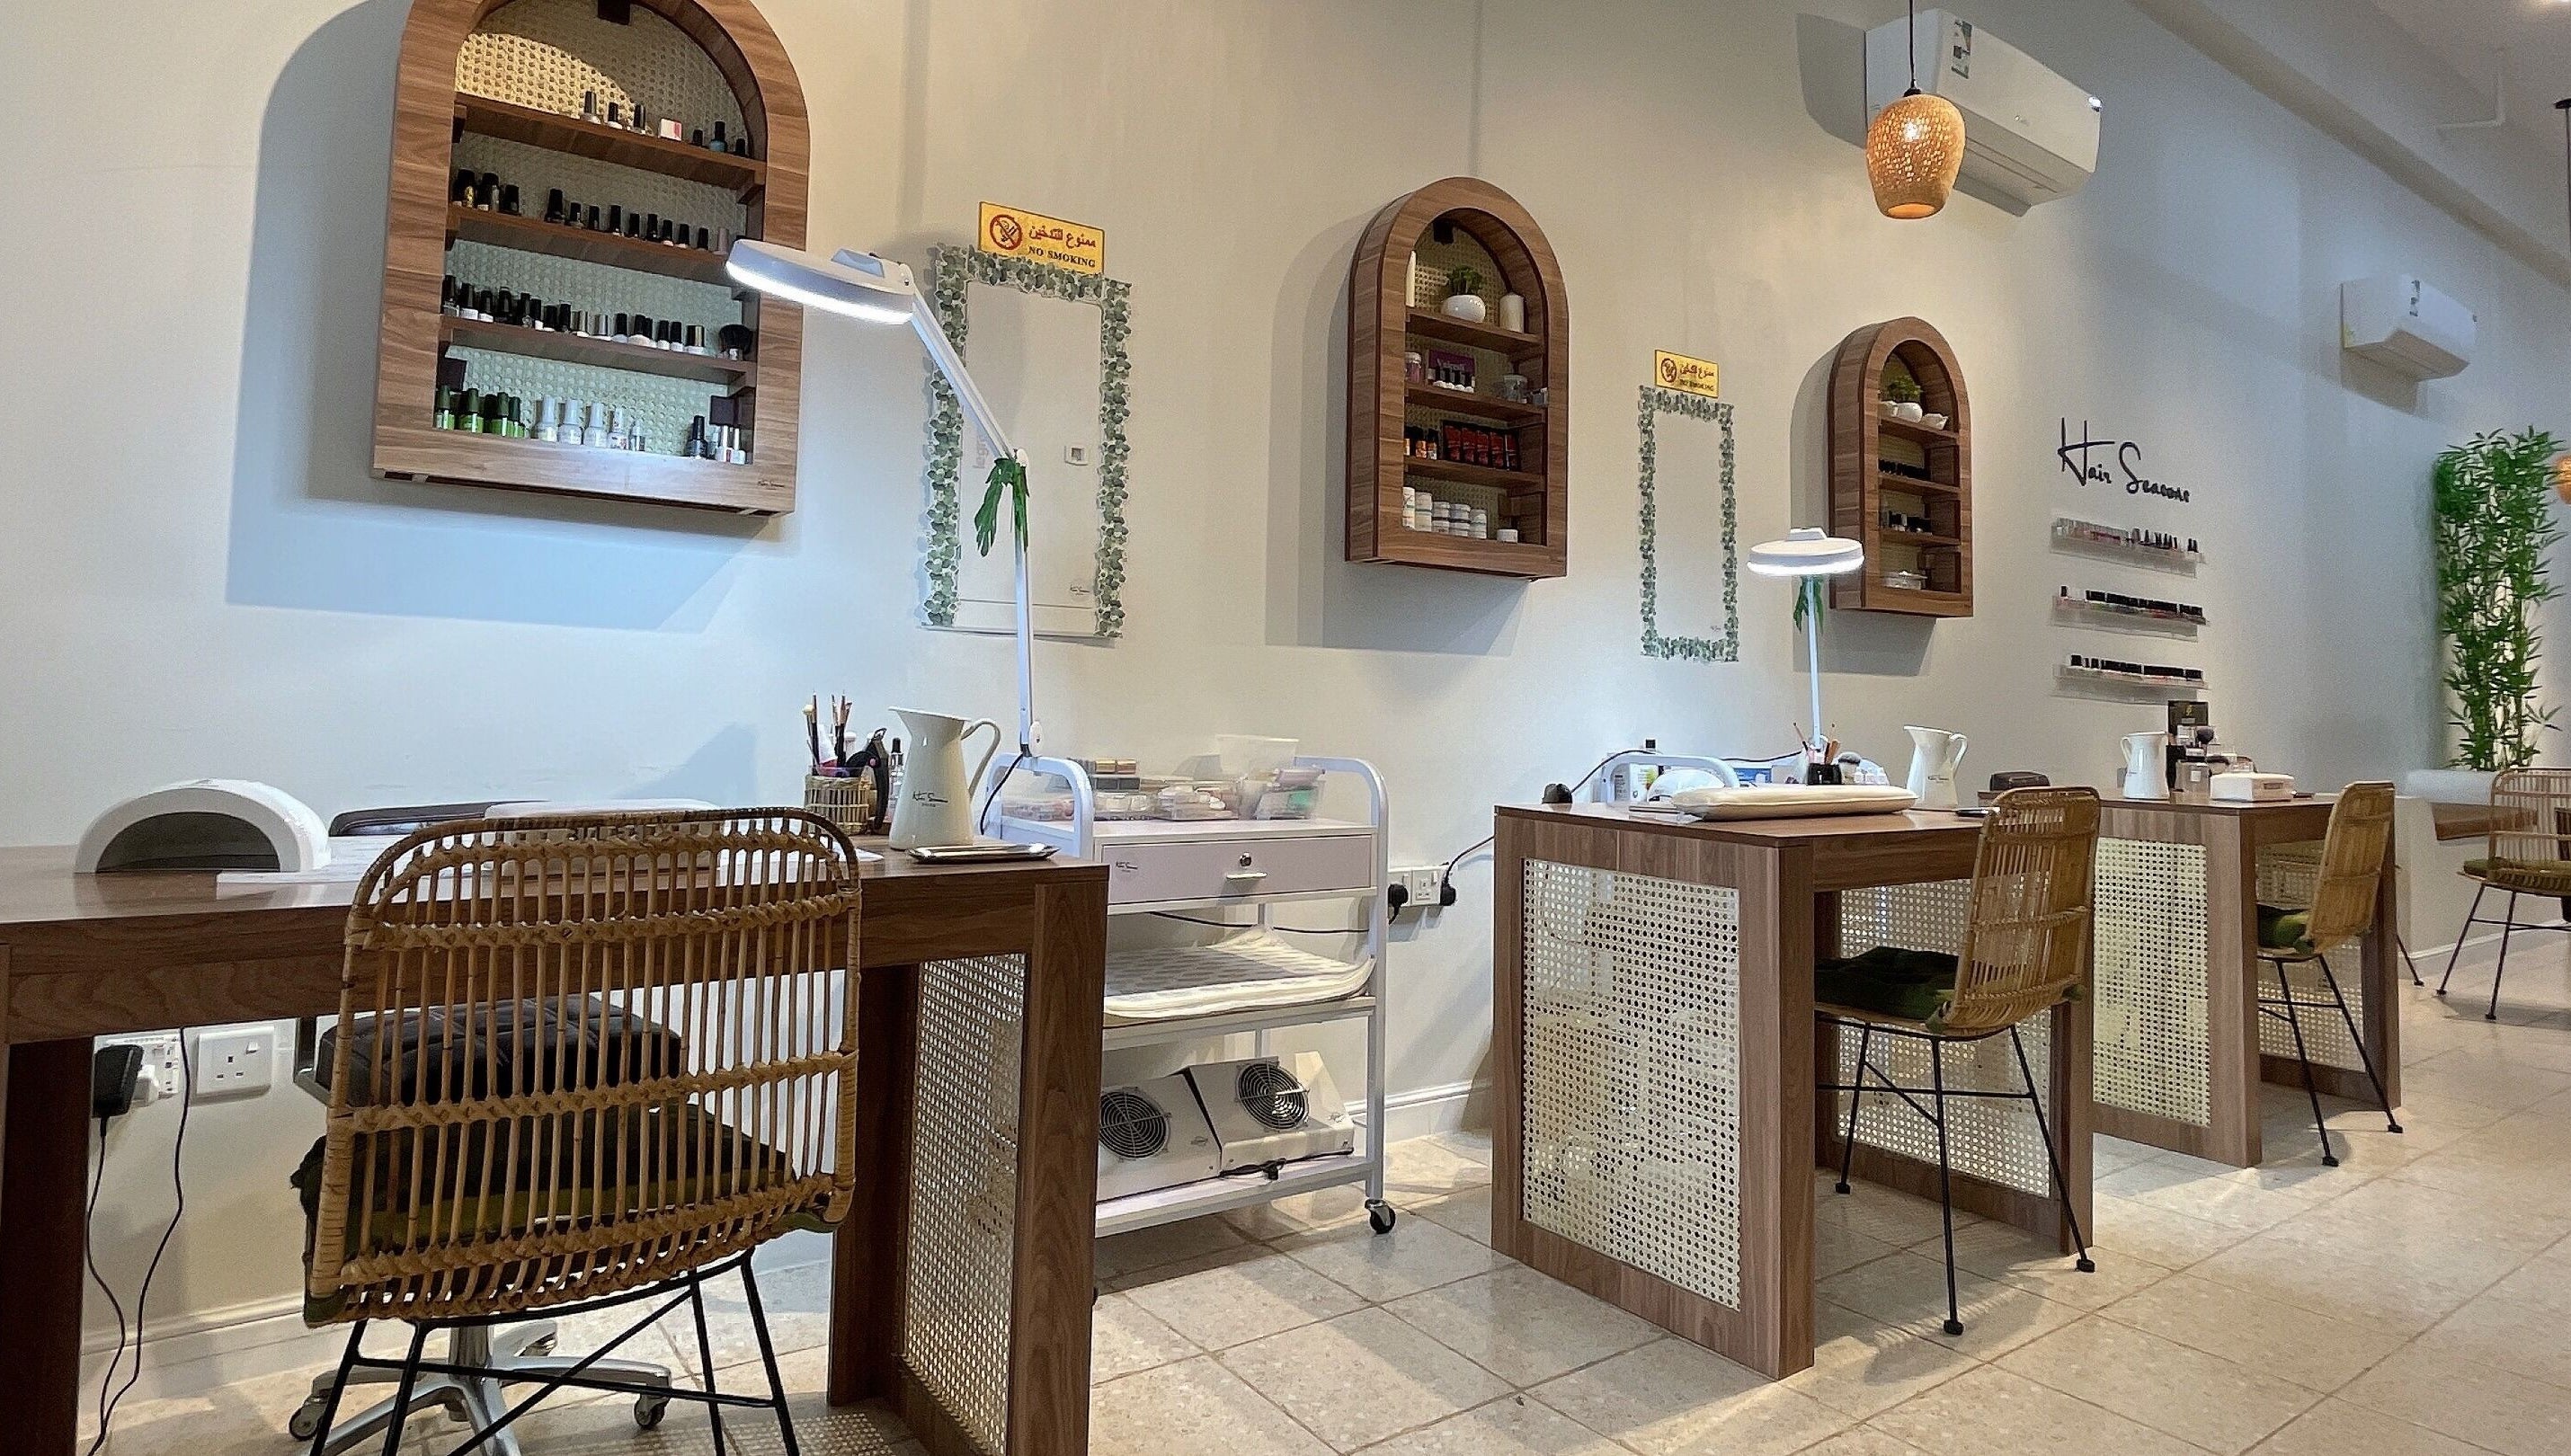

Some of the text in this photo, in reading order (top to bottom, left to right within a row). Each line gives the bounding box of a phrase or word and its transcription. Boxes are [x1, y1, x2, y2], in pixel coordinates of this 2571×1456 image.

[1065, 232, 1097, 249] ممنوع
[1028, 245, 1097, 268] NO SMOKING
[2057, 417, 2115, 486] Hair
